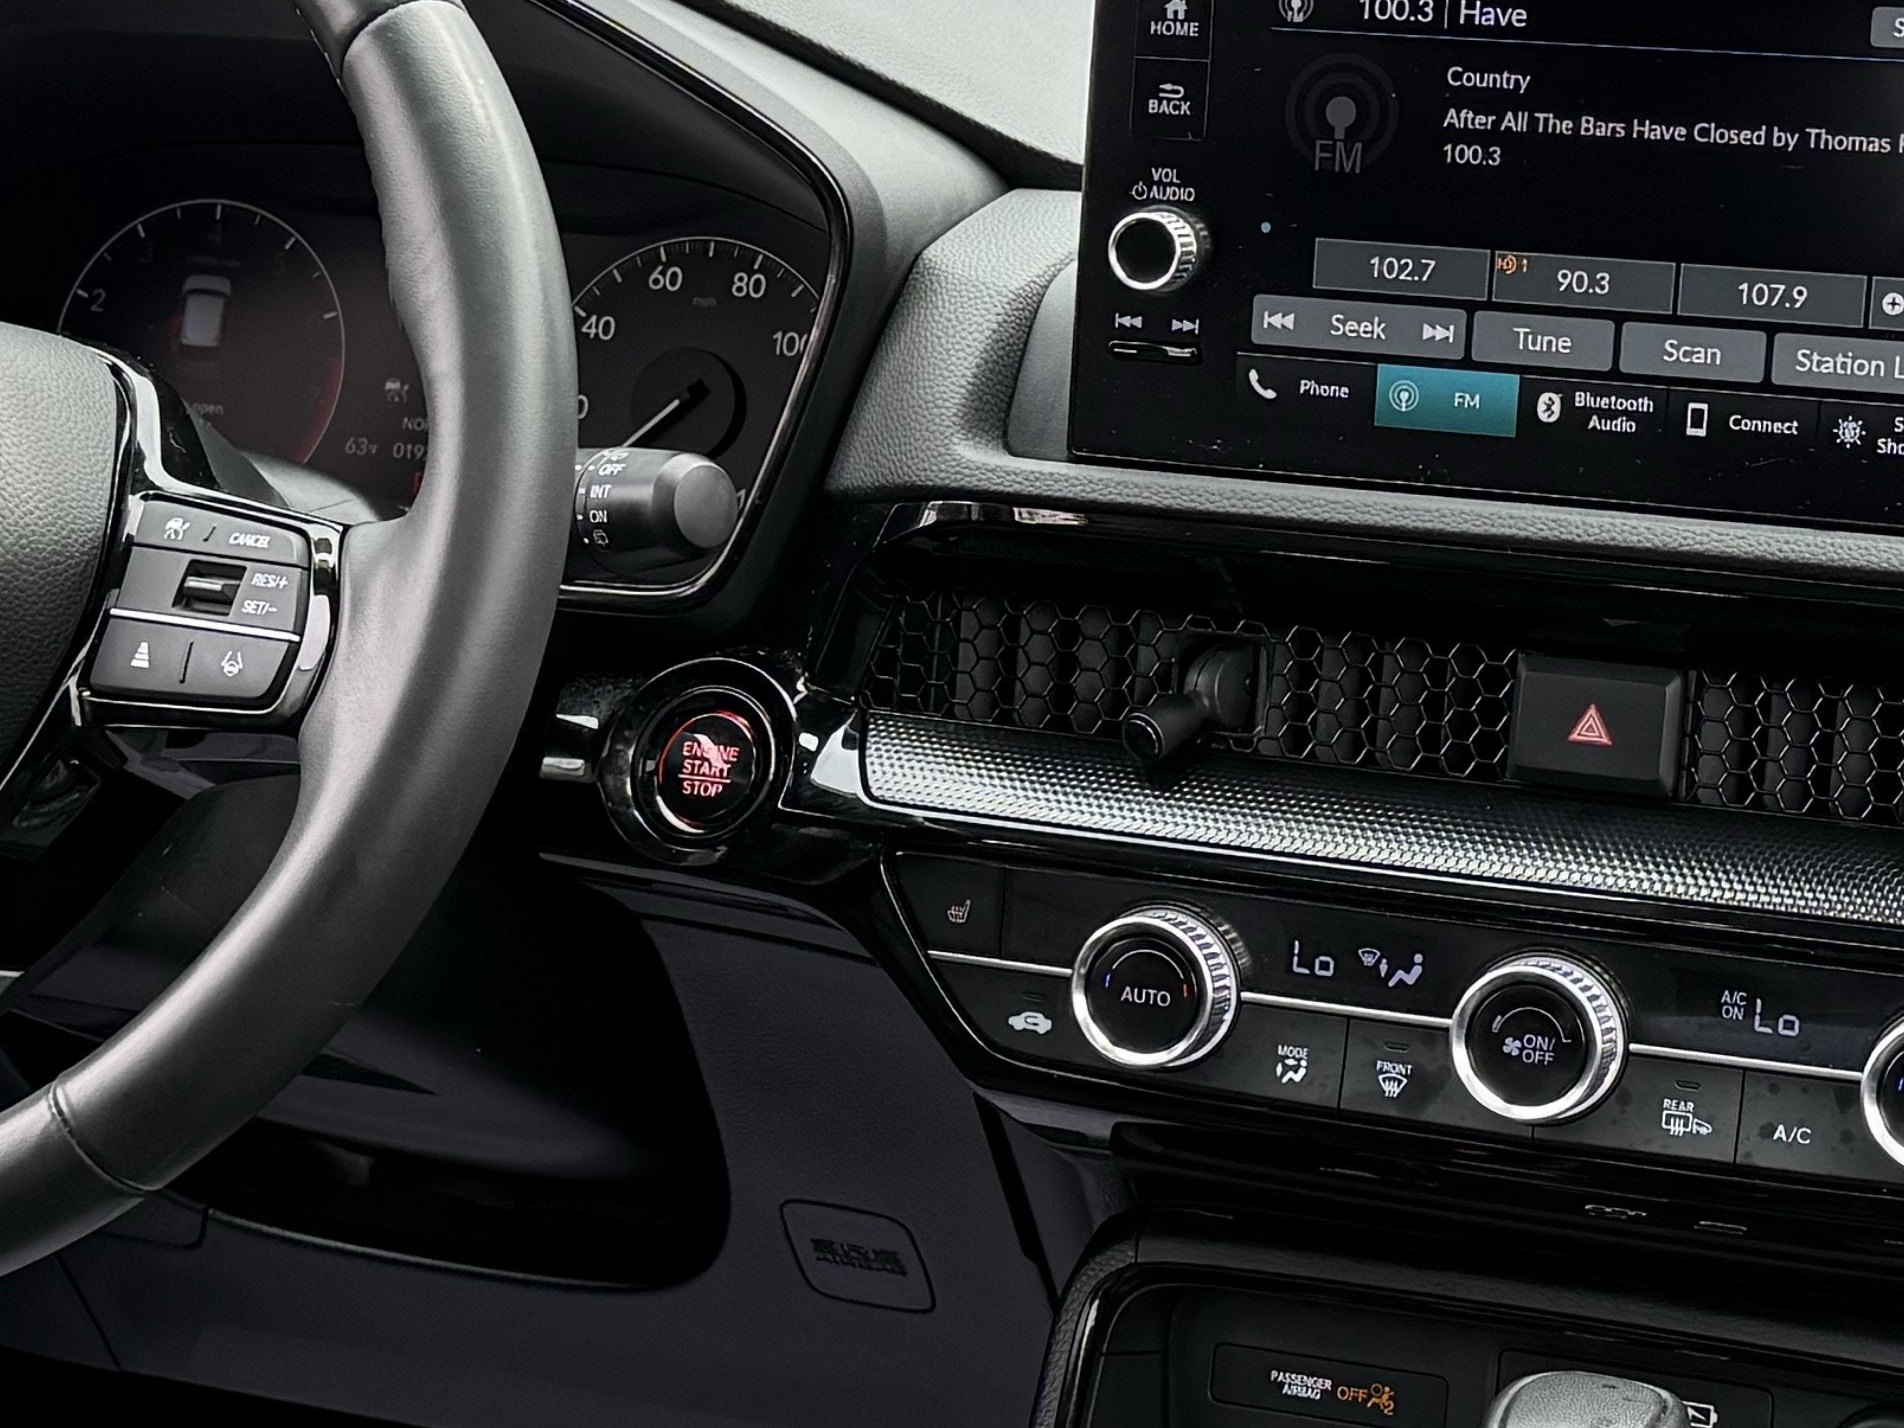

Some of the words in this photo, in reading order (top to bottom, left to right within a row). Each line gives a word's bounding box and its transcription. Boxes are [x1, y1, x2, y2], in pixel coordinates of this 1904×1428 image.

[1459, 0, 1528, 28] Have
[1150, 21, 1199, 37] HOME
[1446, 67, 1531, 94] Country
[1148, 99, 1191, 116] BACK
[1442, 109, 1496, 131] After
[1500, 110, 1529, 132] All
[1533, 111, 1573, 135] The
[1580, 115, 1626, 138] Bars
[1632, 118, 1687, 143] Have
[1693, 122, 1766, 147] Closed
[1772, 125, 1799, 151] by
[1805, 127, 1891, 155] Thomas
[1314, 140, 1364, 174] FM
[1443, 145, 1501, 167] 100.3
[1151, 168, 1181, 183] VOL
[1150, 186, 1195, 202] AUDIO
[648, 265, 683, 292] 60
[1369, 256, 1436, 282] 102.7
[731, 272, 767, 299] 80
[1557, 269, 1610, 295] 90.3
[89, 288, 105, 312] 2
[1737, 281, 1808, 309] 107.9
[581, 315, 616, 341] 40
[1330, 314, 1387, 340] Seek
[1514, 328, 1572, 354] Tune
[1663, 339, 1722, 365] Scan
[1796, 348, 1885, 378] Station
[1300, 379, 1350, 399] Phone
[1454, 392, 1480, 410] FM
[1574, 390, 1654, 414] Bluetooth
[1588, 414, 1636, 433] Audio
[1729, 415, 1798, 435] Connect
[393, 442, 427, 460] 019
[598, 463, 627, 476] OFF
[590, 483, 612, 499] INT
[589, 509, 607, 523] ON
[228, 531, 272, 549] CANCEL
[682, 759, 732, 778] START
[682, 780, 723, 798] STOP
[1120, 985, 1171, 1008] AUTO
[1721, 989, 1747, 1008] A/C
[1721, 1005, 1745, 1021] ON
[1278, 1044, 1309, 1060] MODE
[1523, 1049, 1554, 1066] OFF
[1376, 1060, 1413, 1076] FRONT
[1663, 1099, 1695, 1114] REAR
[1773, 1123, 1812, 1146] A/C
[1270, 1370, 1333, 1391] PASSENGER
[1282, 1383, 1321, 1401] AIRBAG
[1337, 1385, 1368, 1403] OFF
